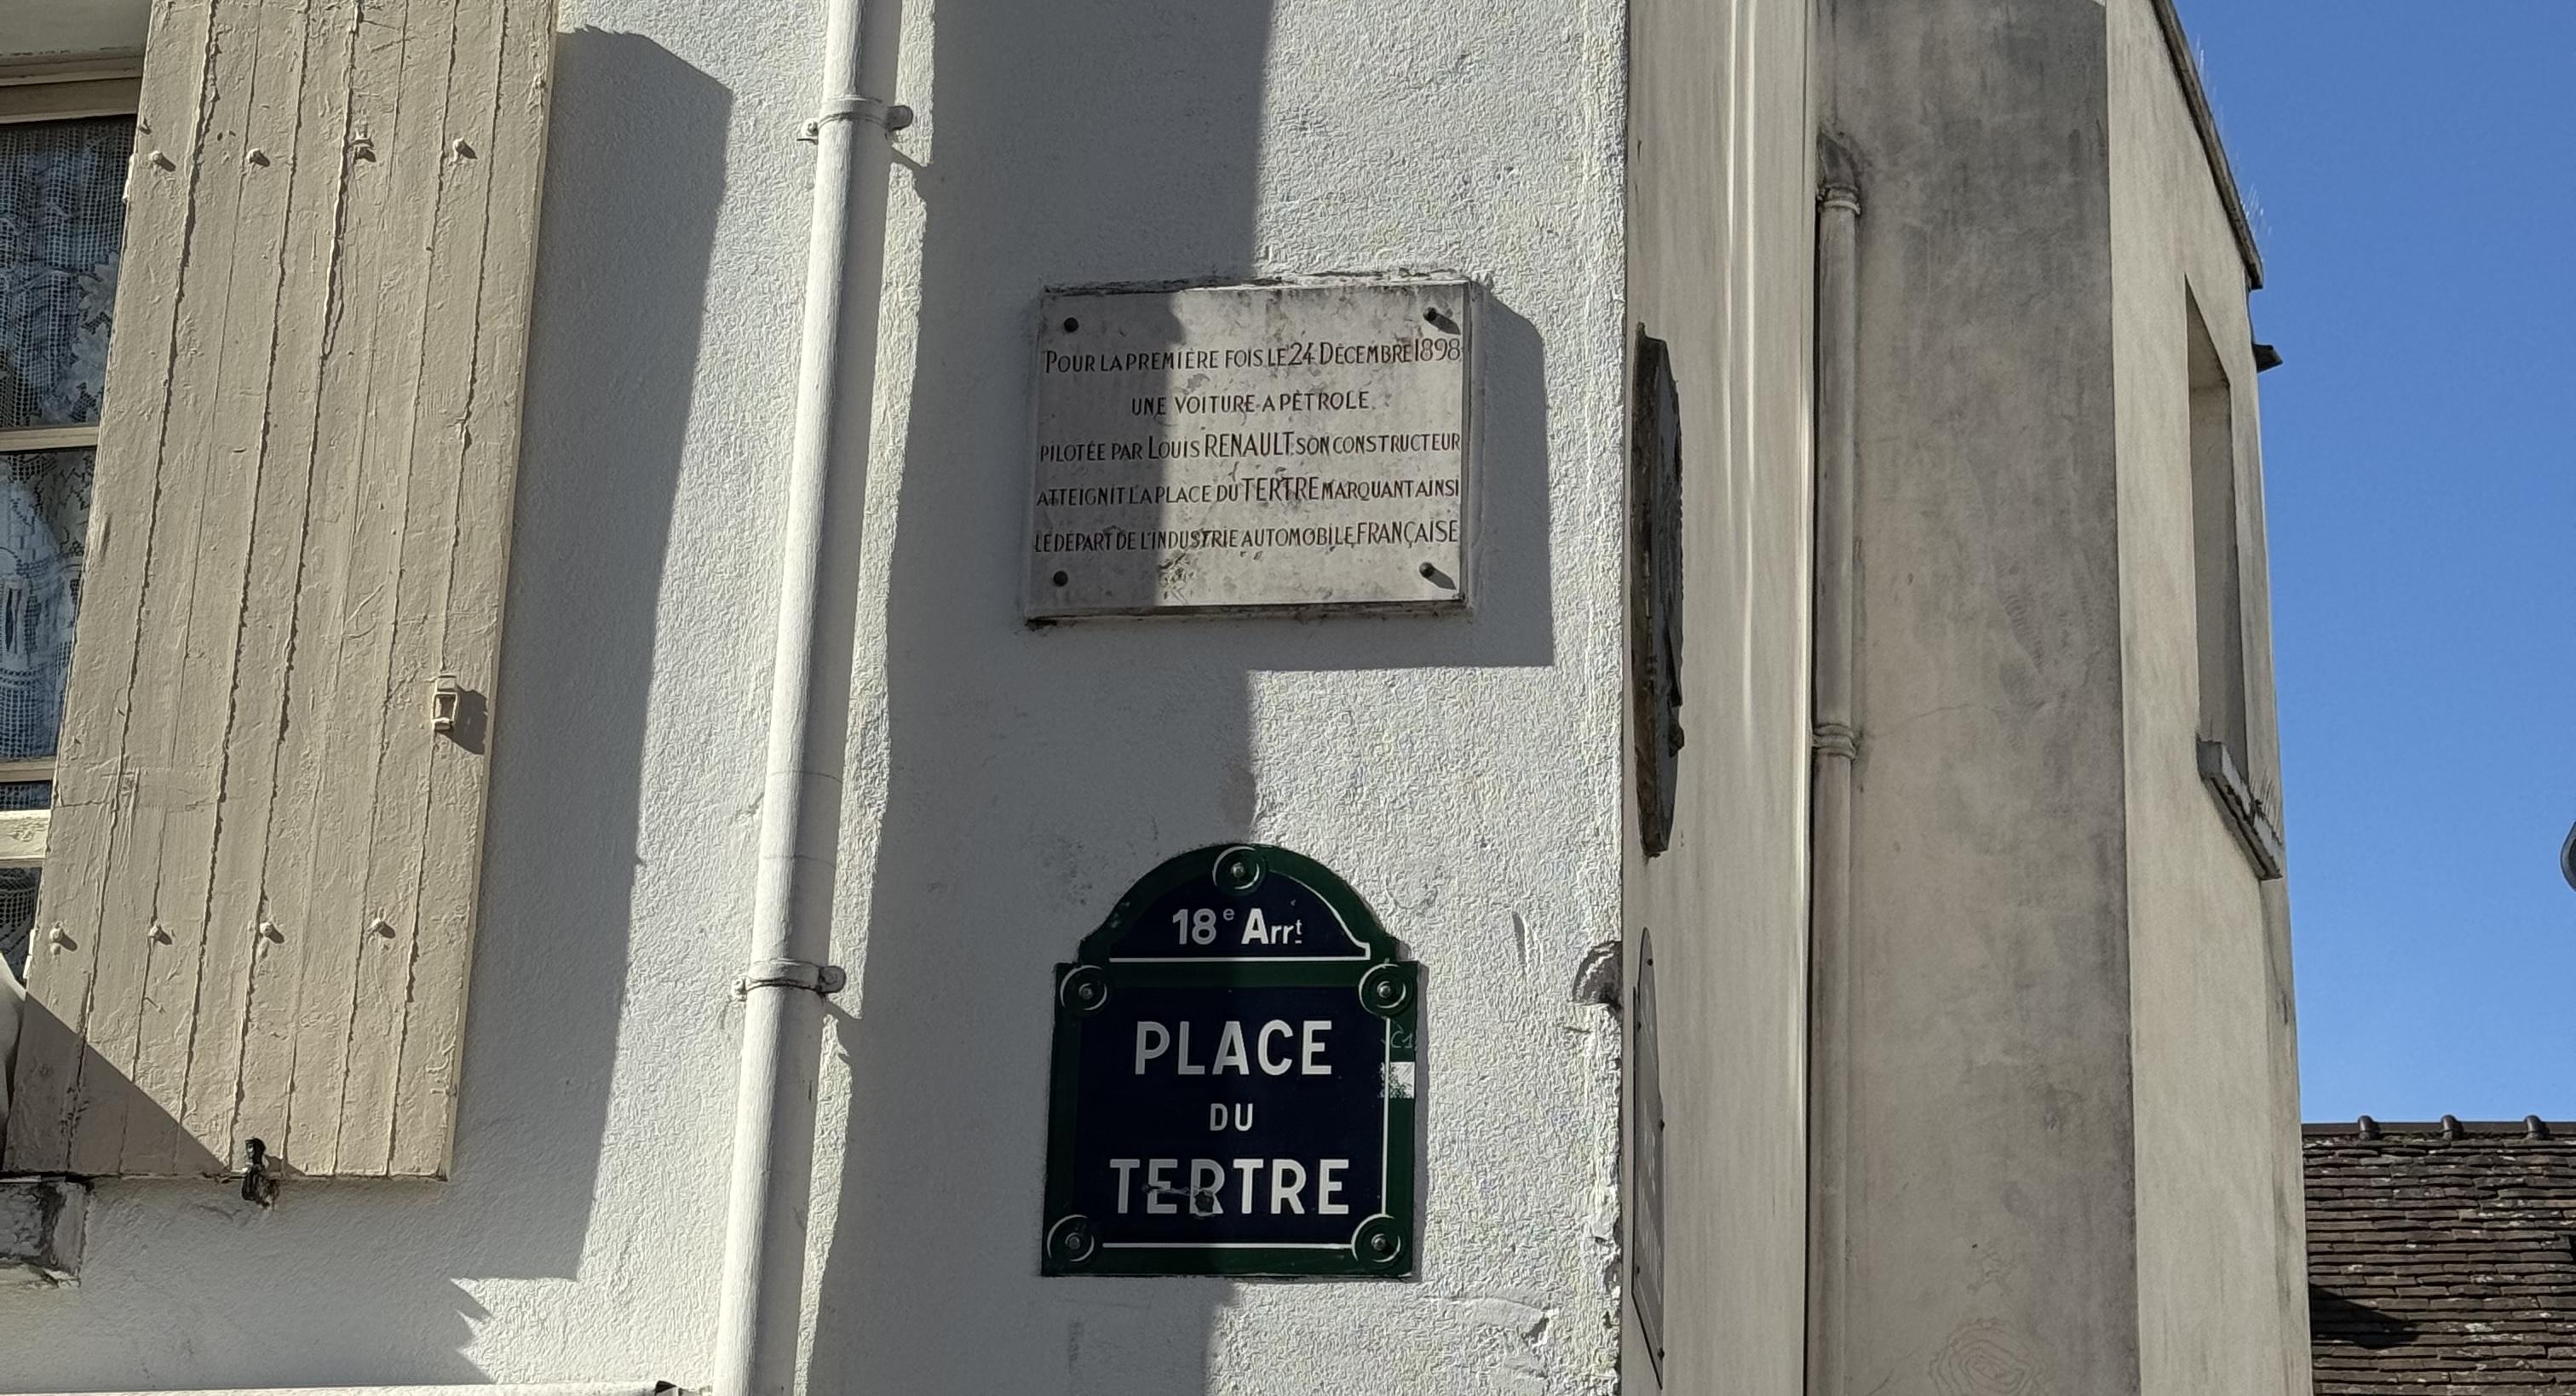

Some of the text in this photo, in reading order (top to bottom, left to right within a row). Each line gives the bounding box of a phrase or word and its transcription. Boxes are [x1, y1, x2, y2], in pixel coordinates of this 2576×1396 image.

[1045, 350, 1095, 373] POUR
[1101, 353, 1123, 371] LA
[1225, 349, 1263, 368] FOIS
[1268, 348, 1287, 366] LE
[1288, 342, 1315, 365] 24
[1131, 397, 1166, 416] UNE
[1175, 395, 1255, 413] VOITURE
[1040, 440, 1106, 462] PILOTÉE
[1111, 443, 1142, 460] PAR
[1296, 436, 1330, 456] SON
[1332, 433, 1461, 454] CONSTRUCTEUR
[1036, 477, 1459, 507] ATTEIGNIT LA PLACE DU TERTRE MARQUANT AINSI
[1035, 533, 1052, 552] LE
[1115, 531, 1137, 550] DE
[1240, 526, 1354, 548] AUTOMOBILE
[1356, 520, 1459, 549] FRANÇAISE
[1135, 1020, 1332, 1075] PLACE
[1210, 1103, 1253, 1131] DU
[1110, 1158, 1349, 1215] TERTRE
